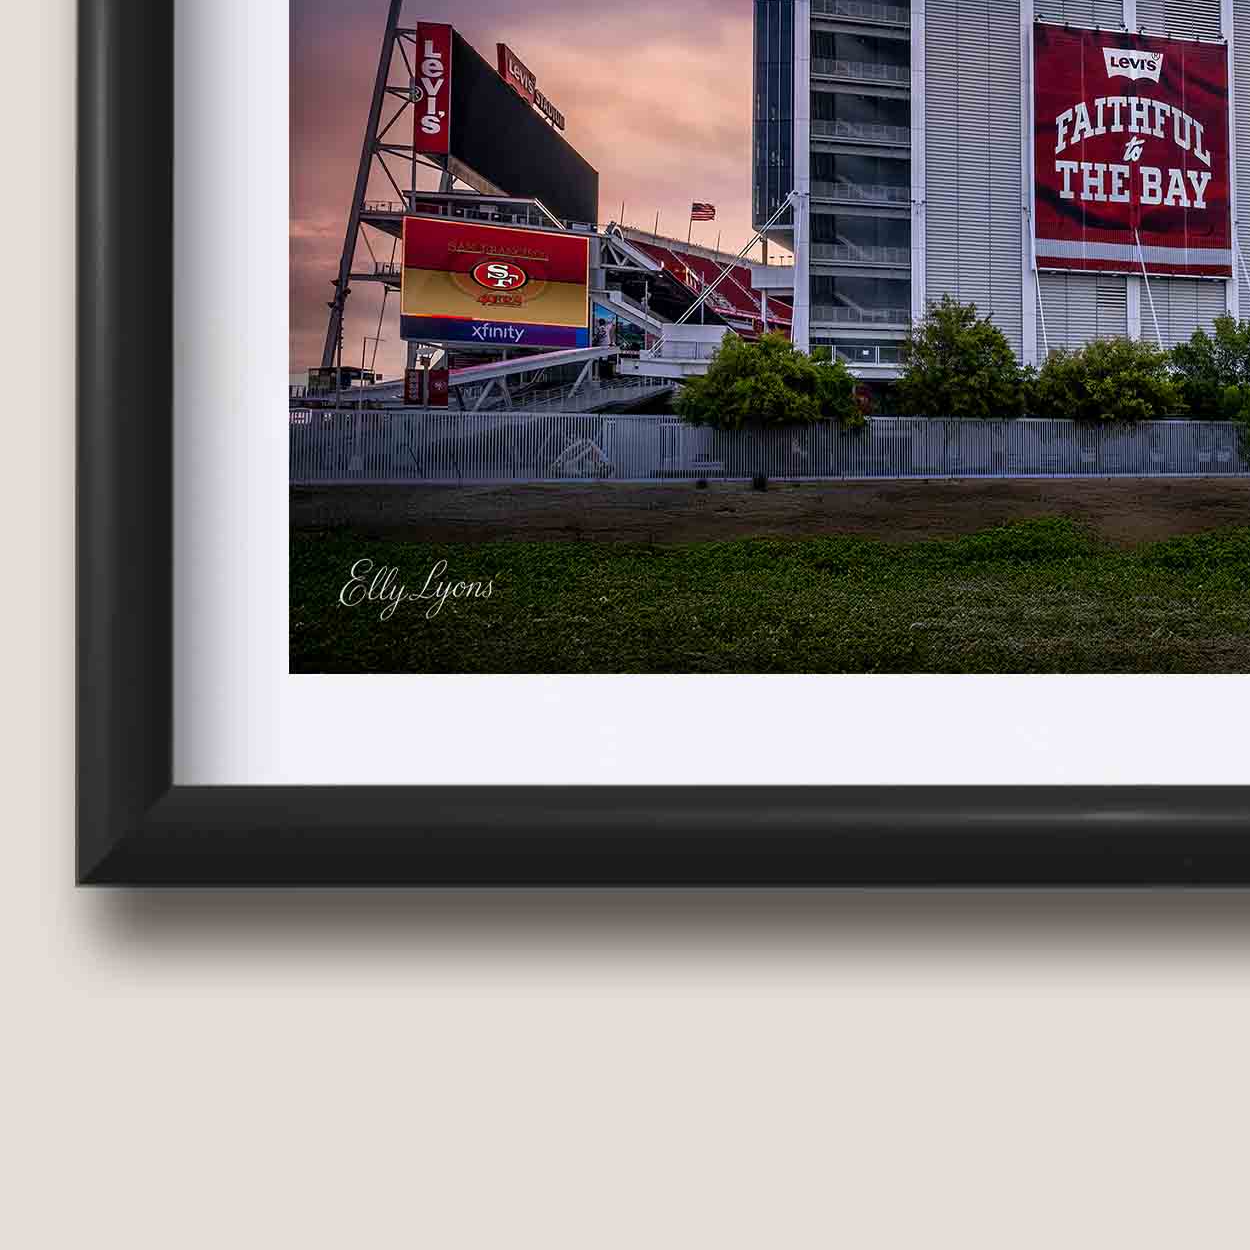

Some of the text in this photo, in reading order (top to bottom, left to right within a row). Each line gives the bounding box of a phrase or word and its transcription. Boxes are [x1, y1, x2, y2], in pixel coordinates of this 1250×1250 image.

[1055, 96, 1211, 168] FAITHFUL
[1123, 135, 1146, 163] to
[1055, 160, 1212, 210] THE BAY
[487, 263, 519, 289] SF
[471, 323, 525, 342] xfinity
